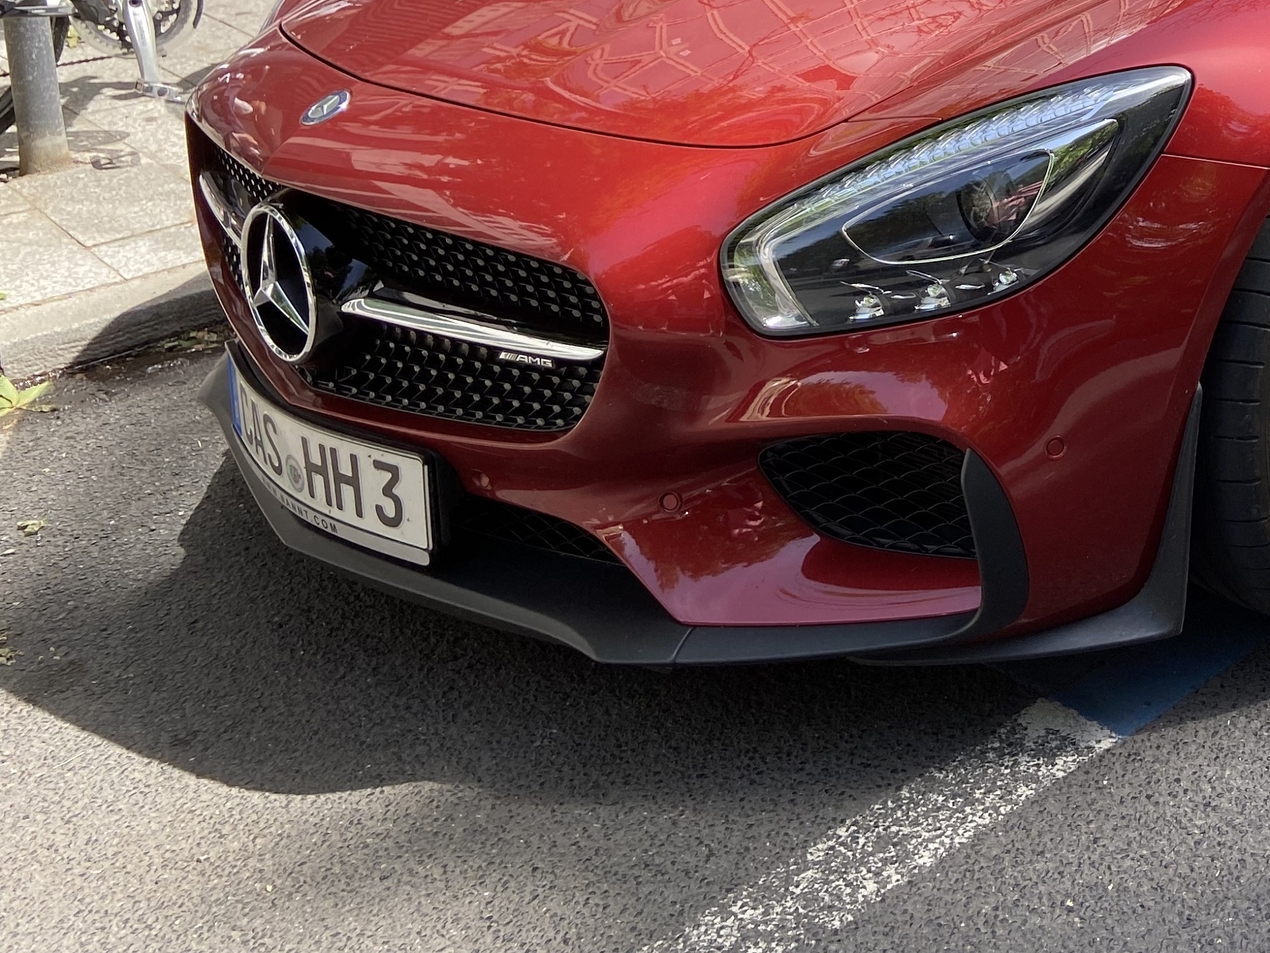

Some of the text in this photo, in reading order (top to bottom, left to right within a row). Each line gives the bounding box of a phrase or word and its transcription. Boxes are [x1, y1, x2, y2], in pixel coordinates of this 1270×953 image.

[515, 354, 554, 368] AMG
[301, 436, 363, 519] HH
[372, 459, 404, 528] 3
